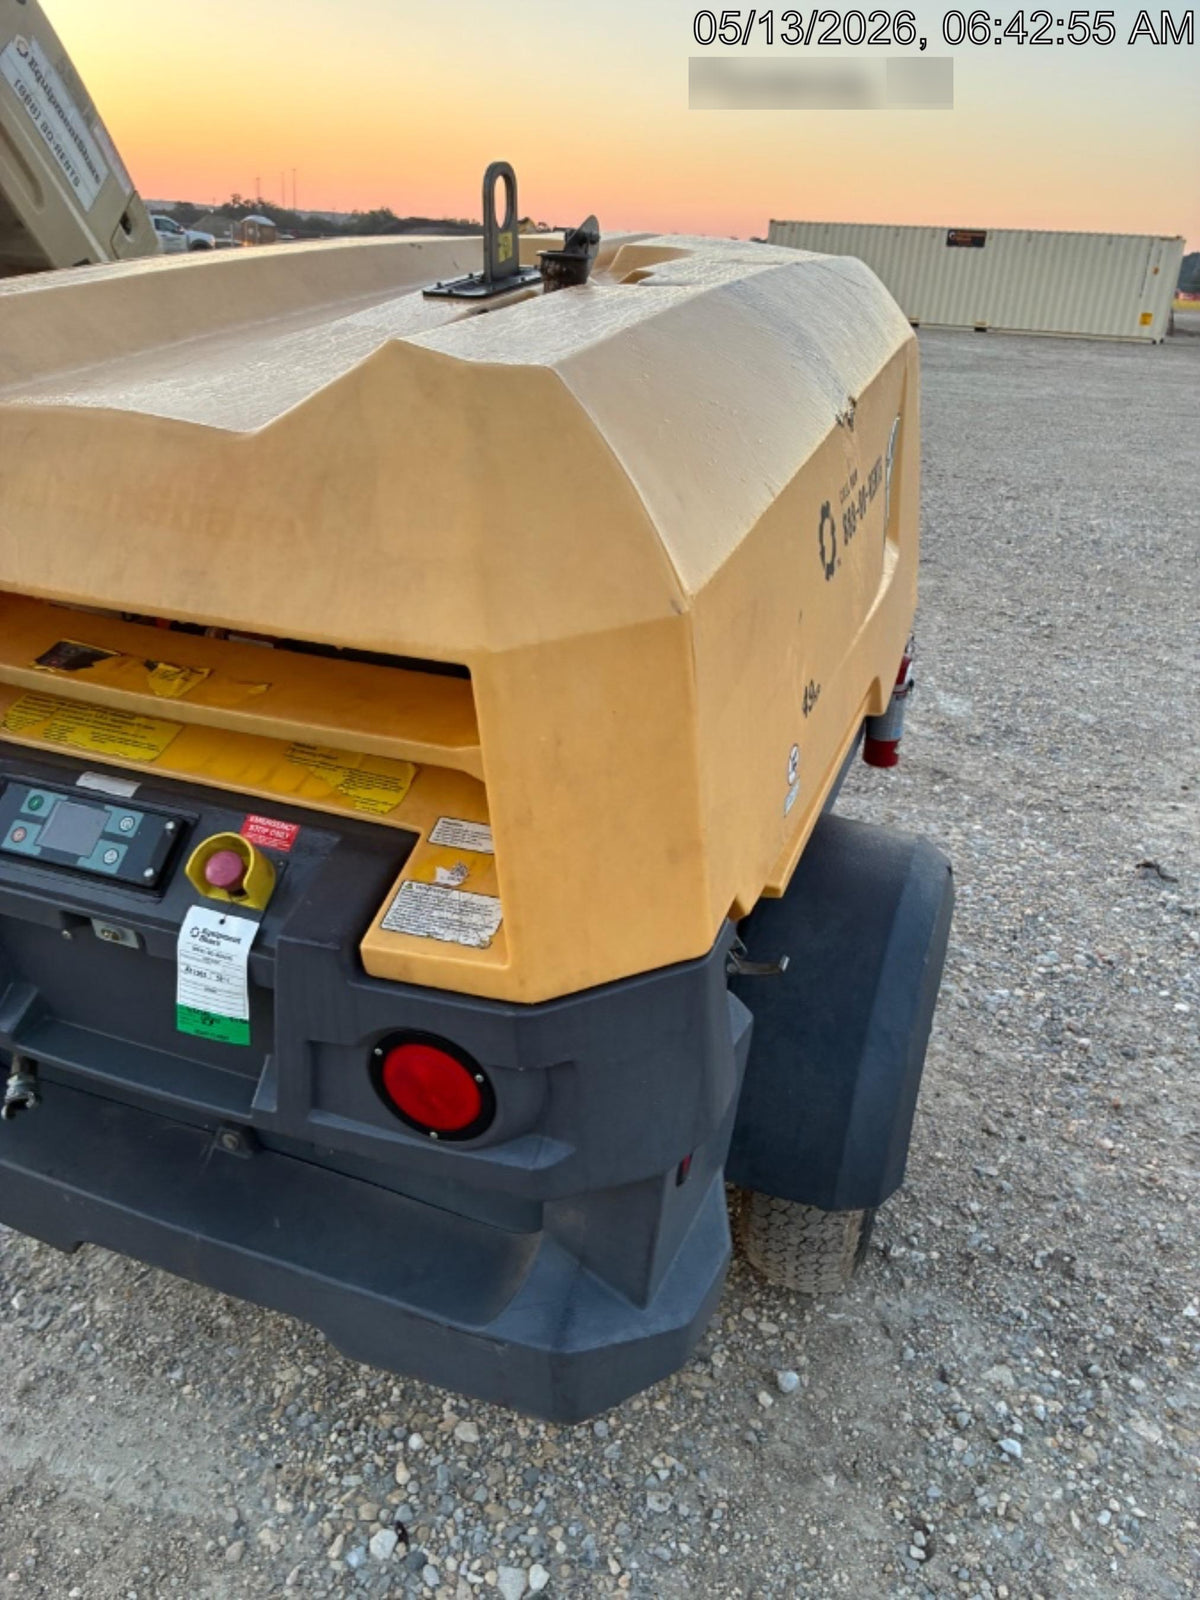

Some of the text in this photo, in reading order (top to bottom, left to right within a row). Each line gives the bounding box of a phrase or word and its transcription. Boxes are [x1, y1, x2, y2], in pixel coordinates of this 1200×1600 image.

[248, 824, 290, 839] STOP ONLY
[249, 815, 297, 832] EMERGENCY
